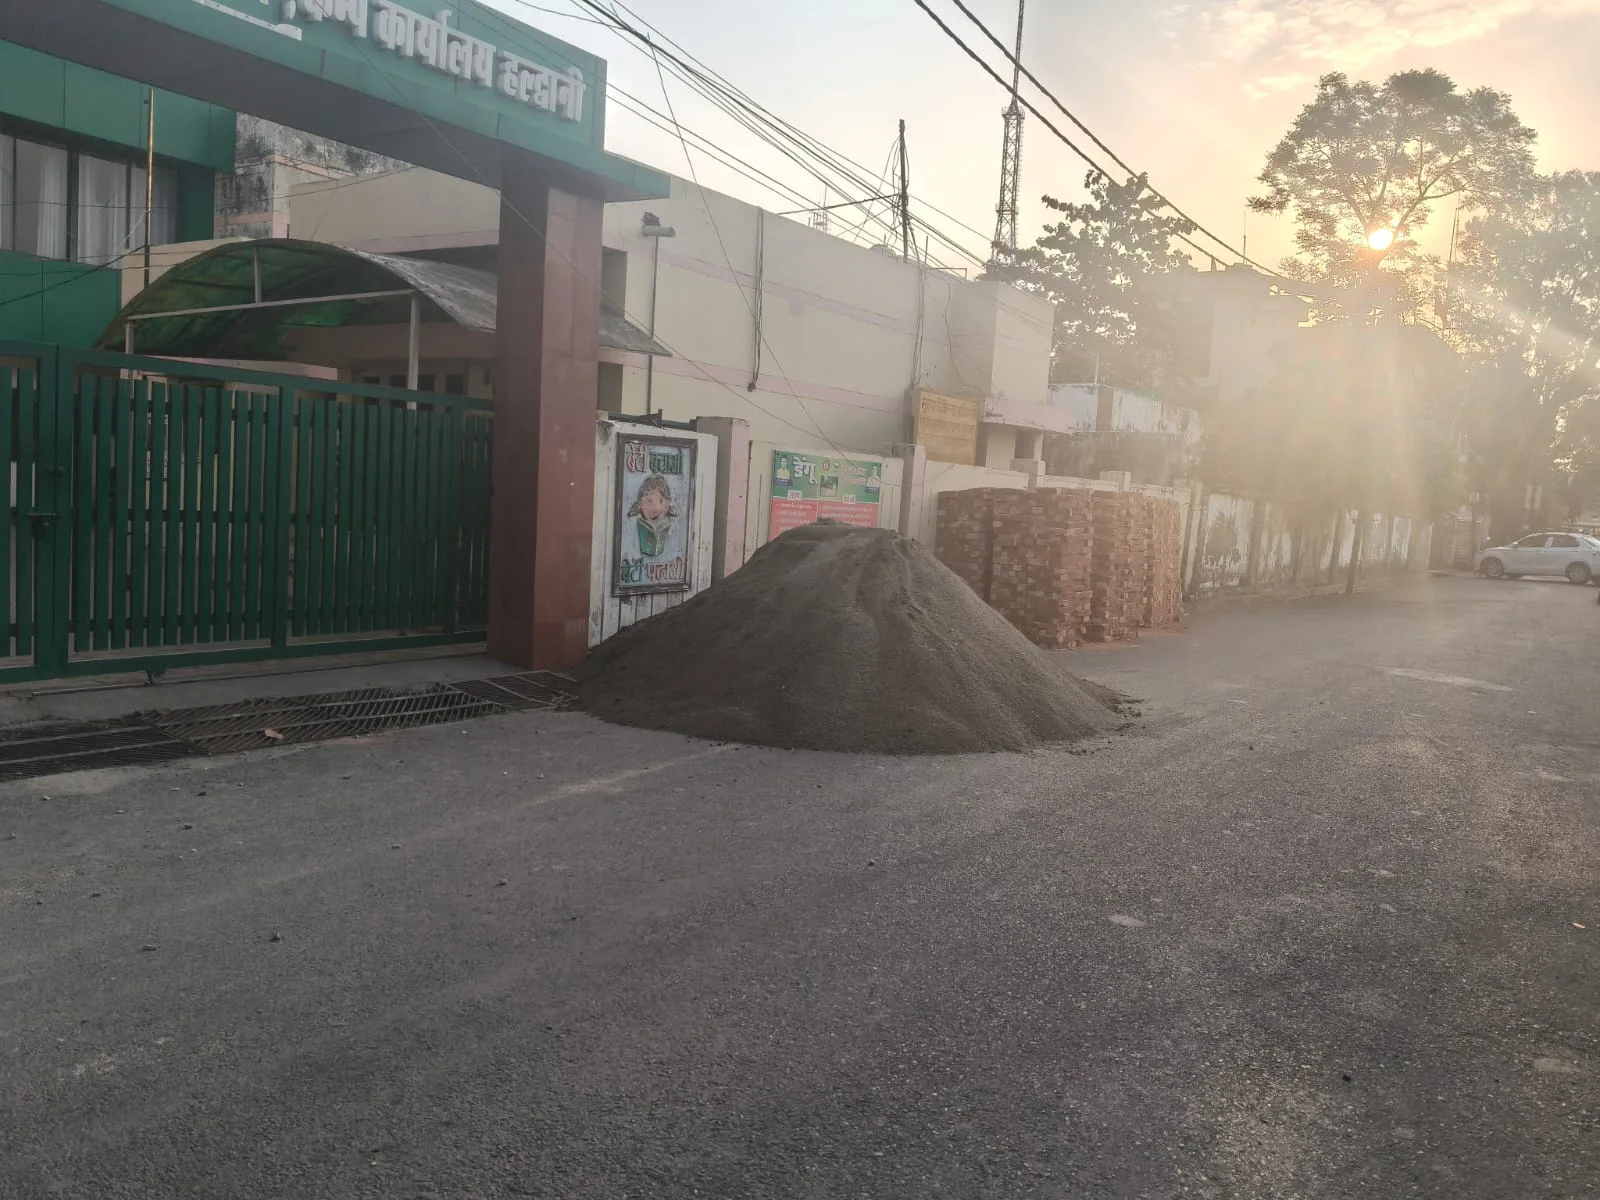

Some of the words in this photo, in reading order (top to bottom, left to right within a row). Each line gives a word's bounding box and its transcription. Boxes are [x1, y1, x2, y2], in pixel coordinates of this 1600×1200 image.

[372, 0, 496, 88] कार्यालय
[626, 443, 648, 473] बेटी
[621, 557, 643, 583] बेटी
